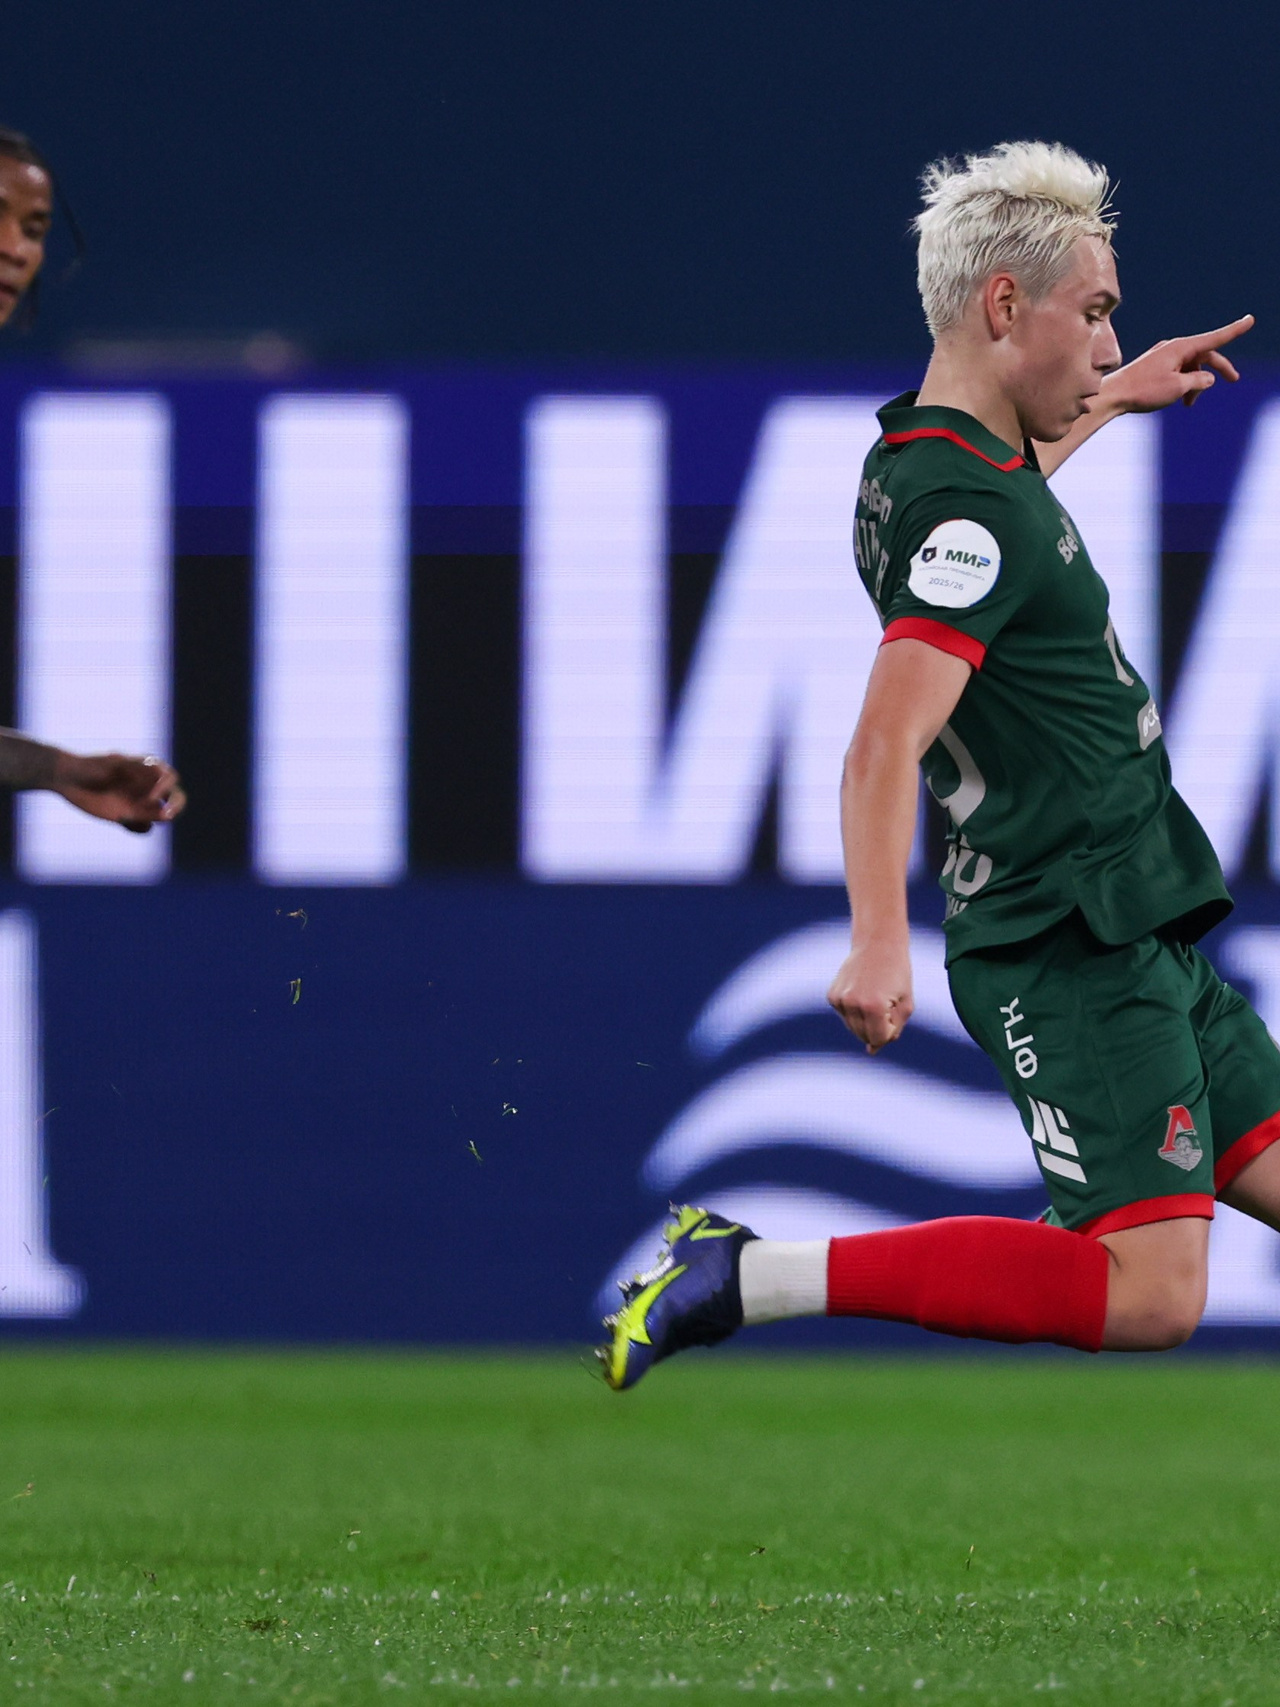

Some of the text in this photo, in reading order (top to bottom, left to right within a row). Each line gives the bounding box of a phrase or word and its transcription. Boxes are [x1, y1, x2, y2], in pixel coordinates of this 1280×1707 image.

[945, 550, 991, 568] МИР
[928, 578, 964, 590] 2025/26
[999, 997, 1038, 1079] ФГК
